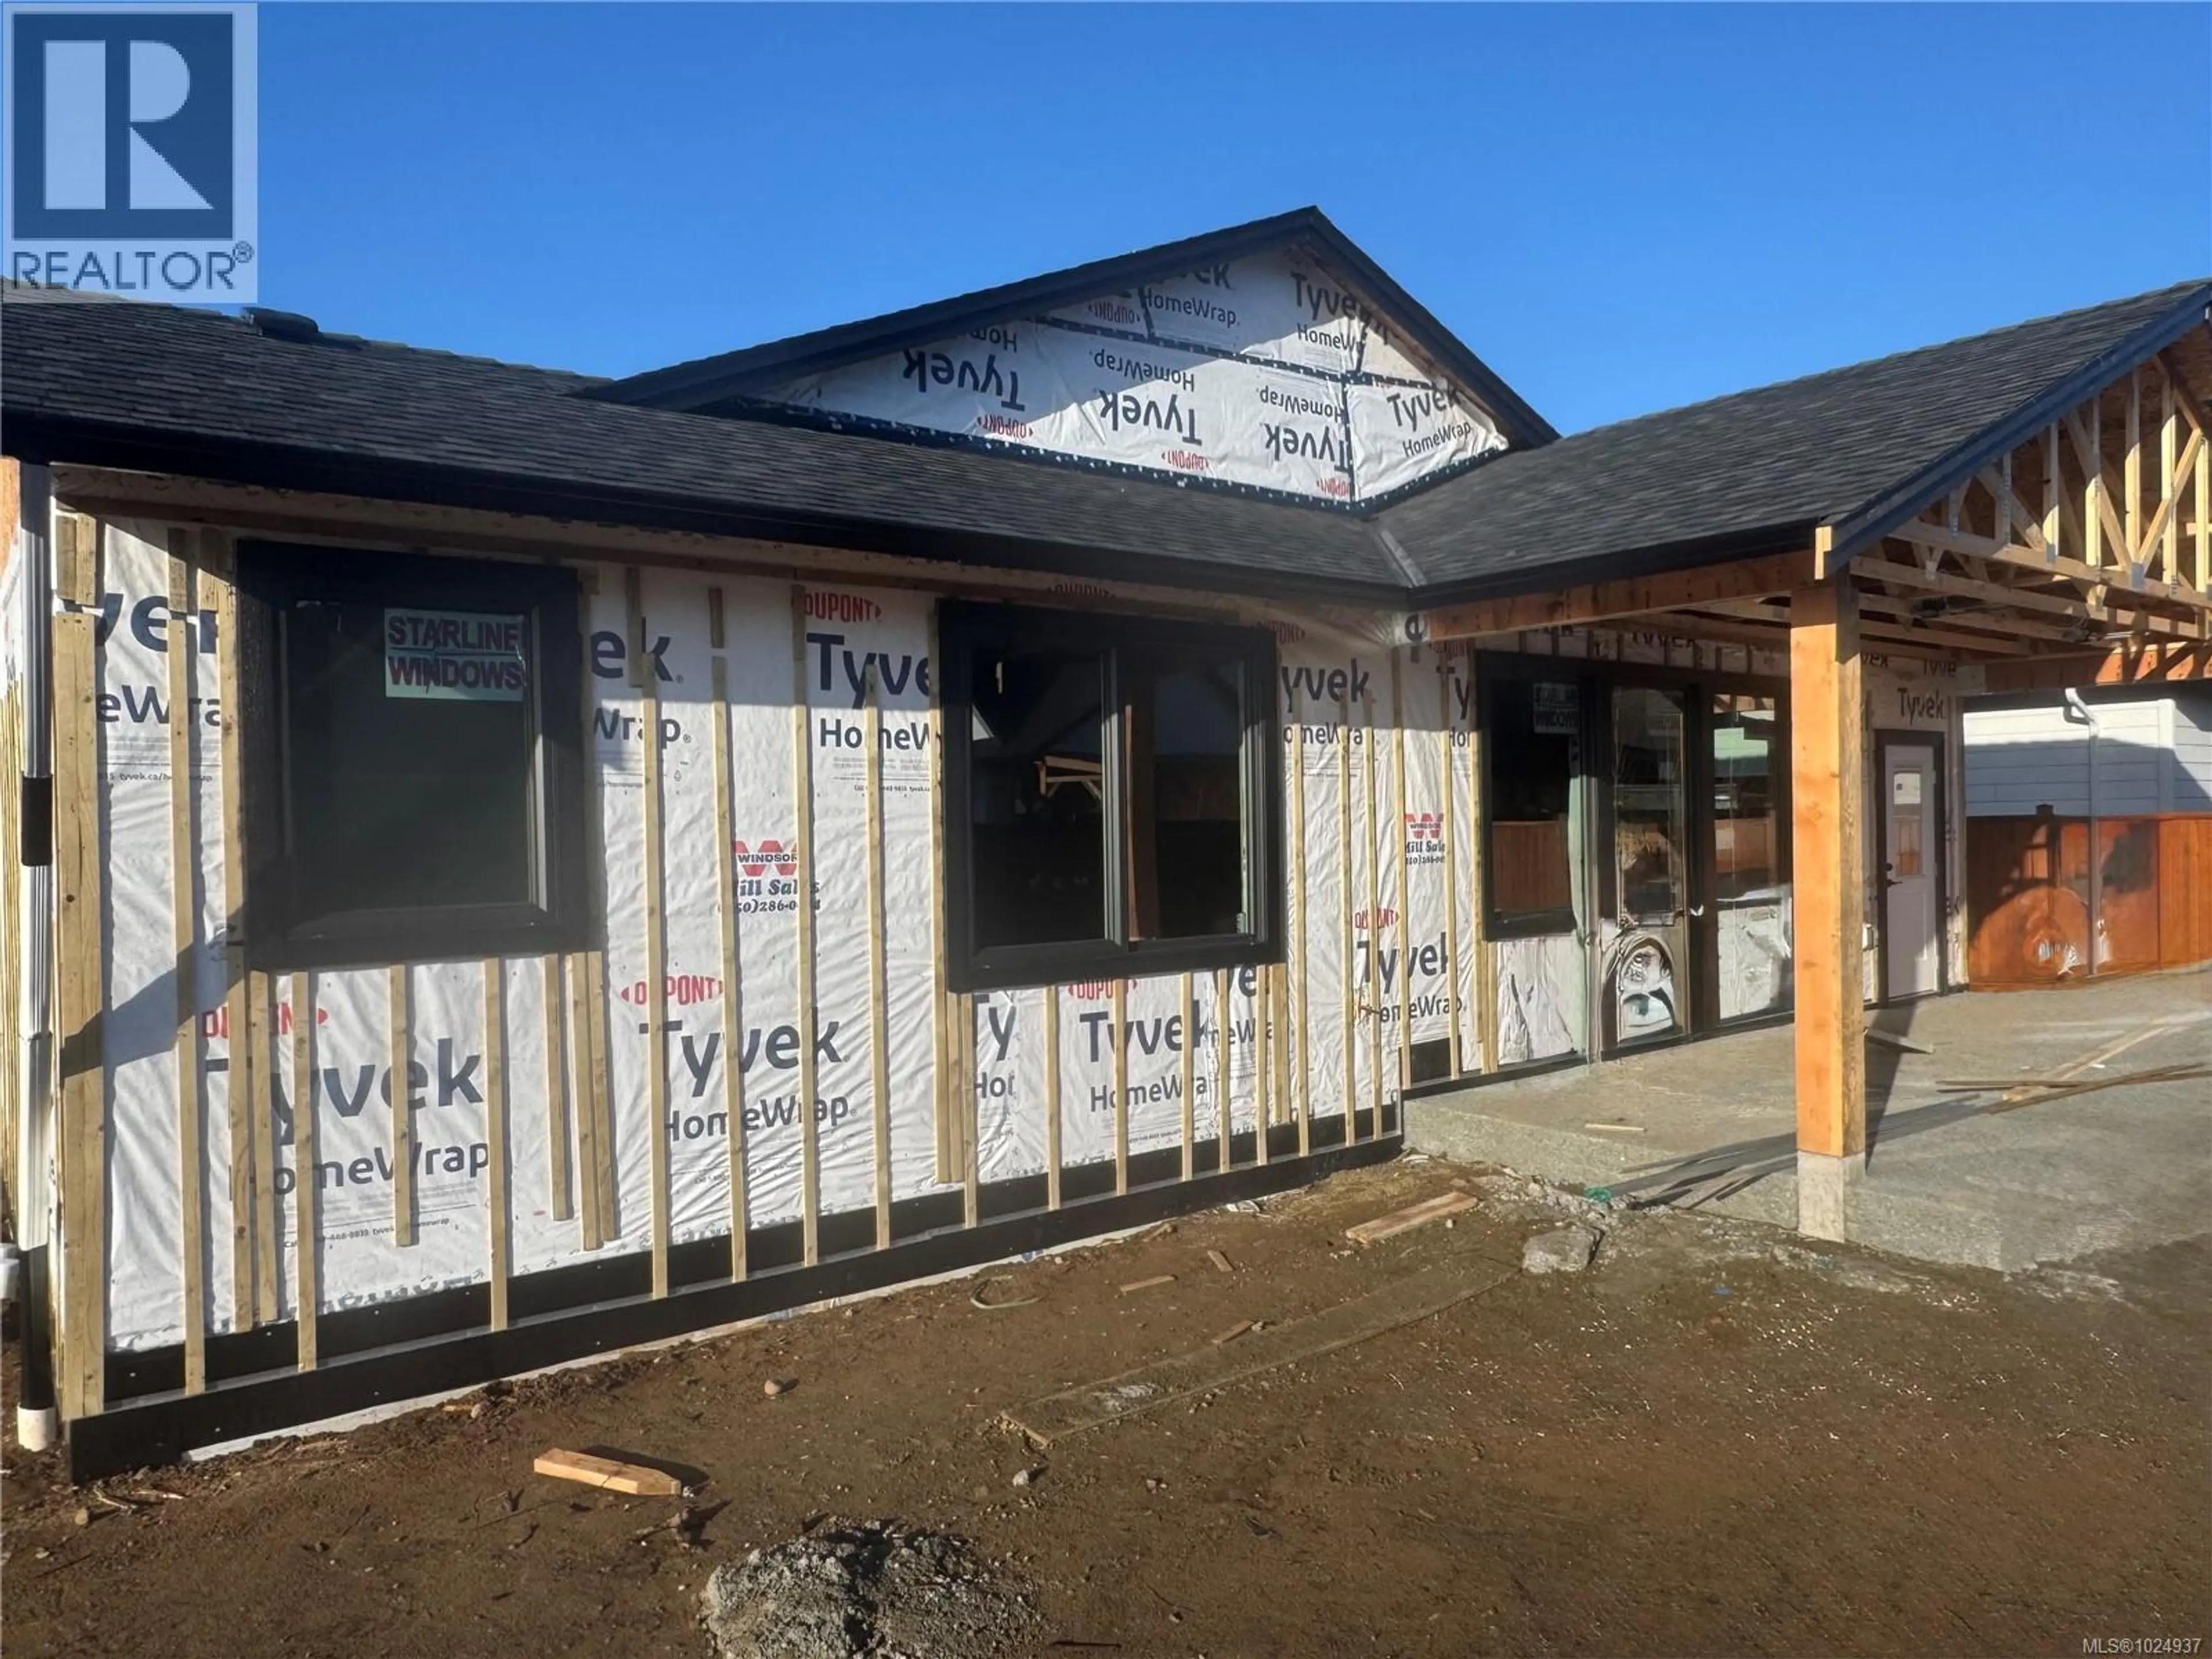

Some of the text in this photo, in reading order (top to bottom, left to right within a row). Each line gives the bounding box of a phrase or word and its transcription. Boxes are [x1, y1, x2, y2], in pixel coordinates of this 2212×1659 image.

[903, 347, 1026, 412] Tyvek
[1094, 348, 1195, 392] HomeWrap
[1099, 389, 1203, 447] Tyvek
[1403, 421, 1471, 459] HomeWrap
[388, 616, 518, 650] STARLINE
[388, 656, 523, 691] WINDOWS
[1897, 687, 1945, 726] Tyvek
[634, 975, 715, 1006] DPONT
